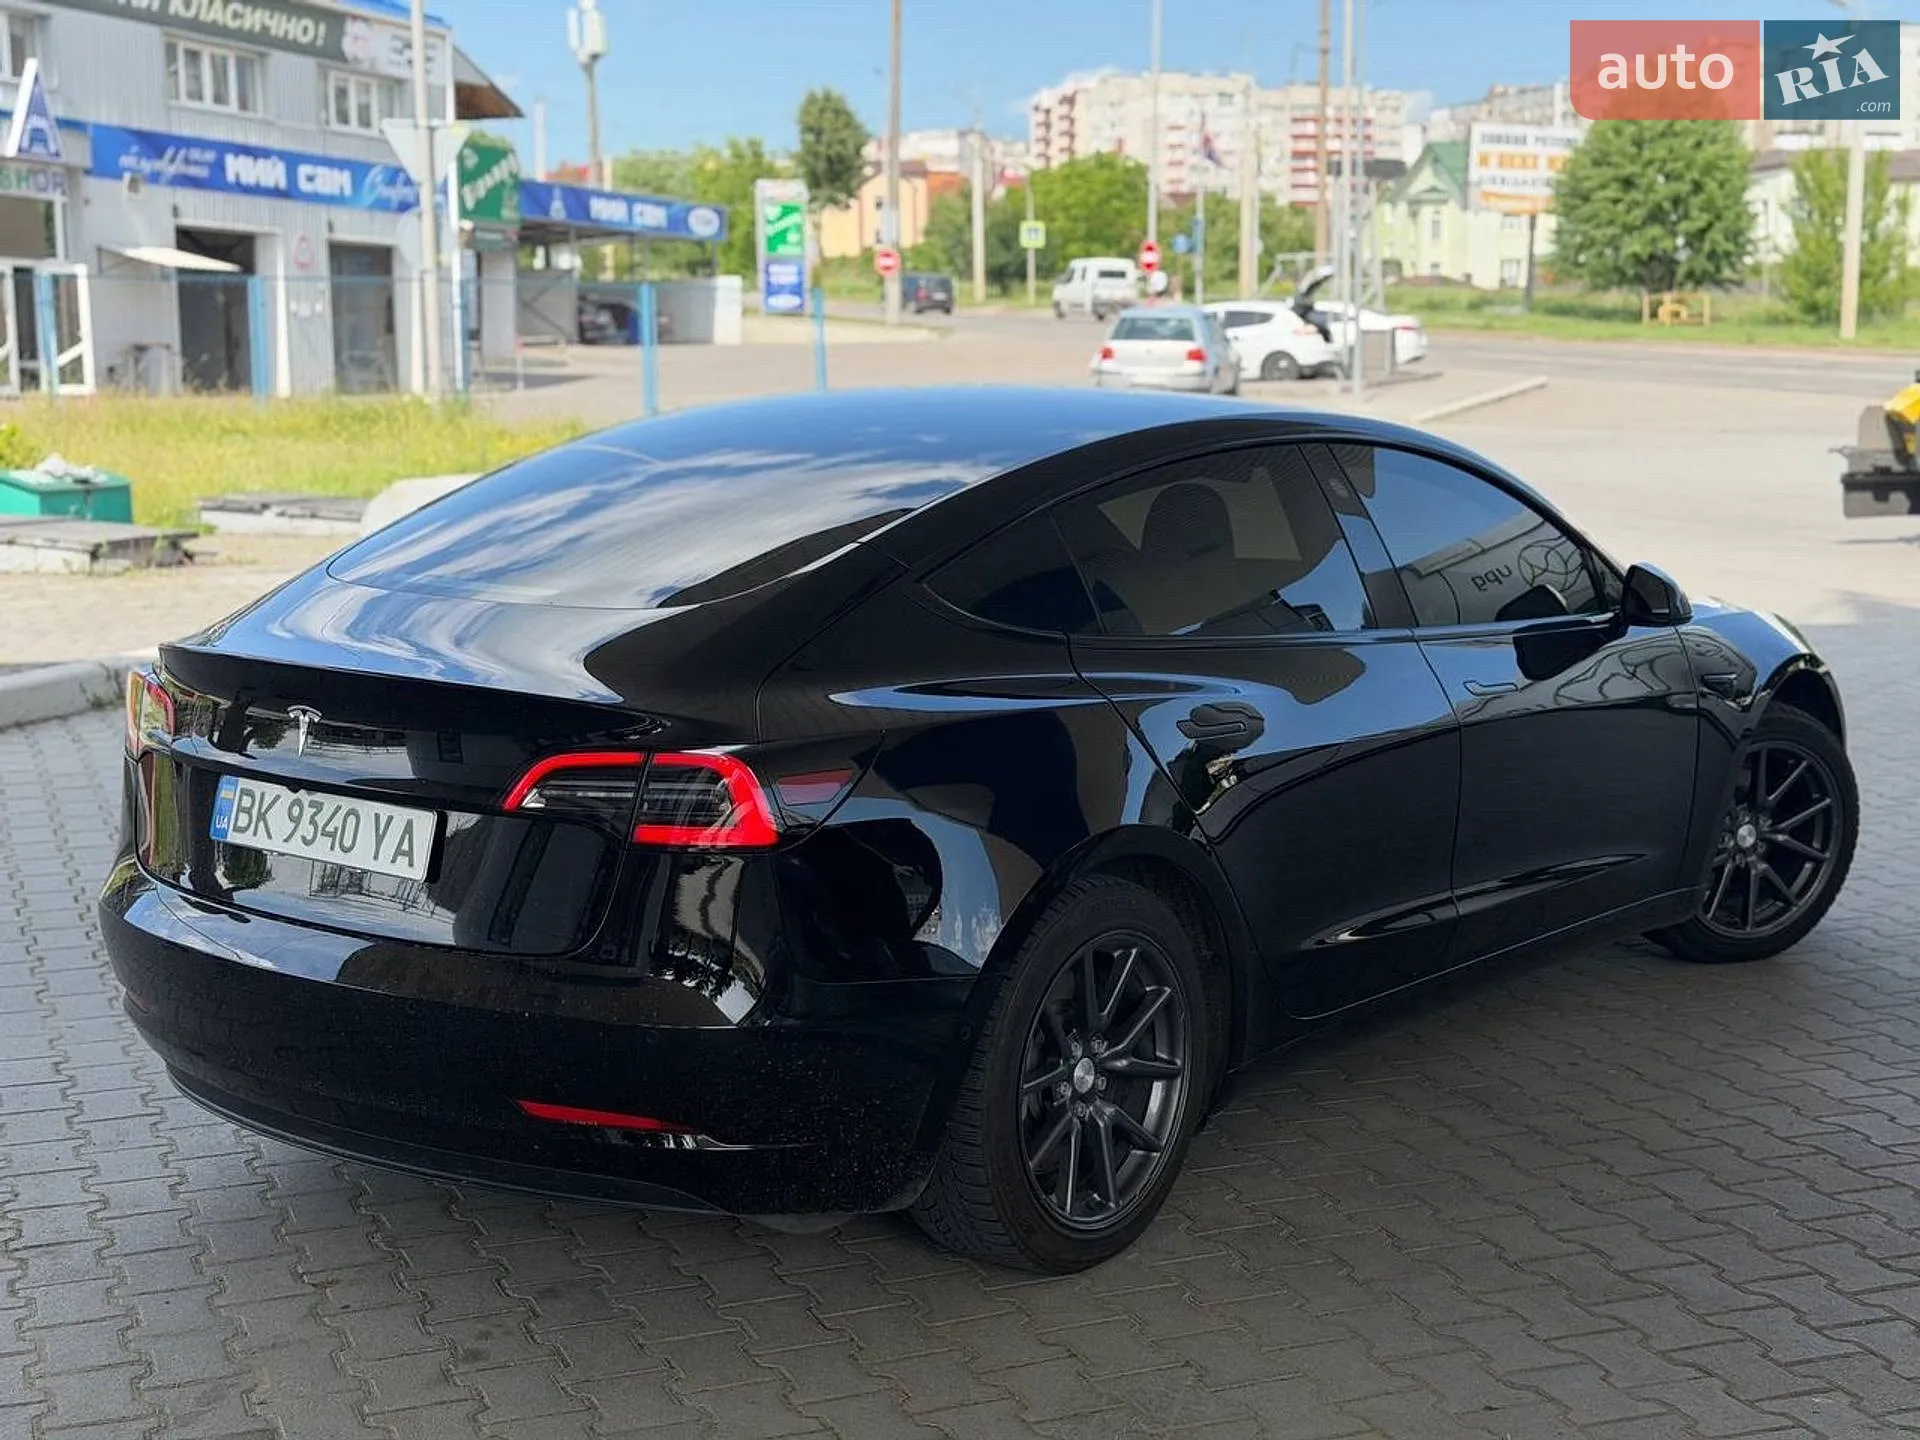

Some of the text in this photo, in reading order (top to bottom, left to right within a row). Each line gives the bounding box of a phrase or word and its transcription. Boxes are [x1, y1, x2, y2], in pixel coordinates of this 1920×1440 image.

[232, 787, 415, 868] BK 9340 YA
